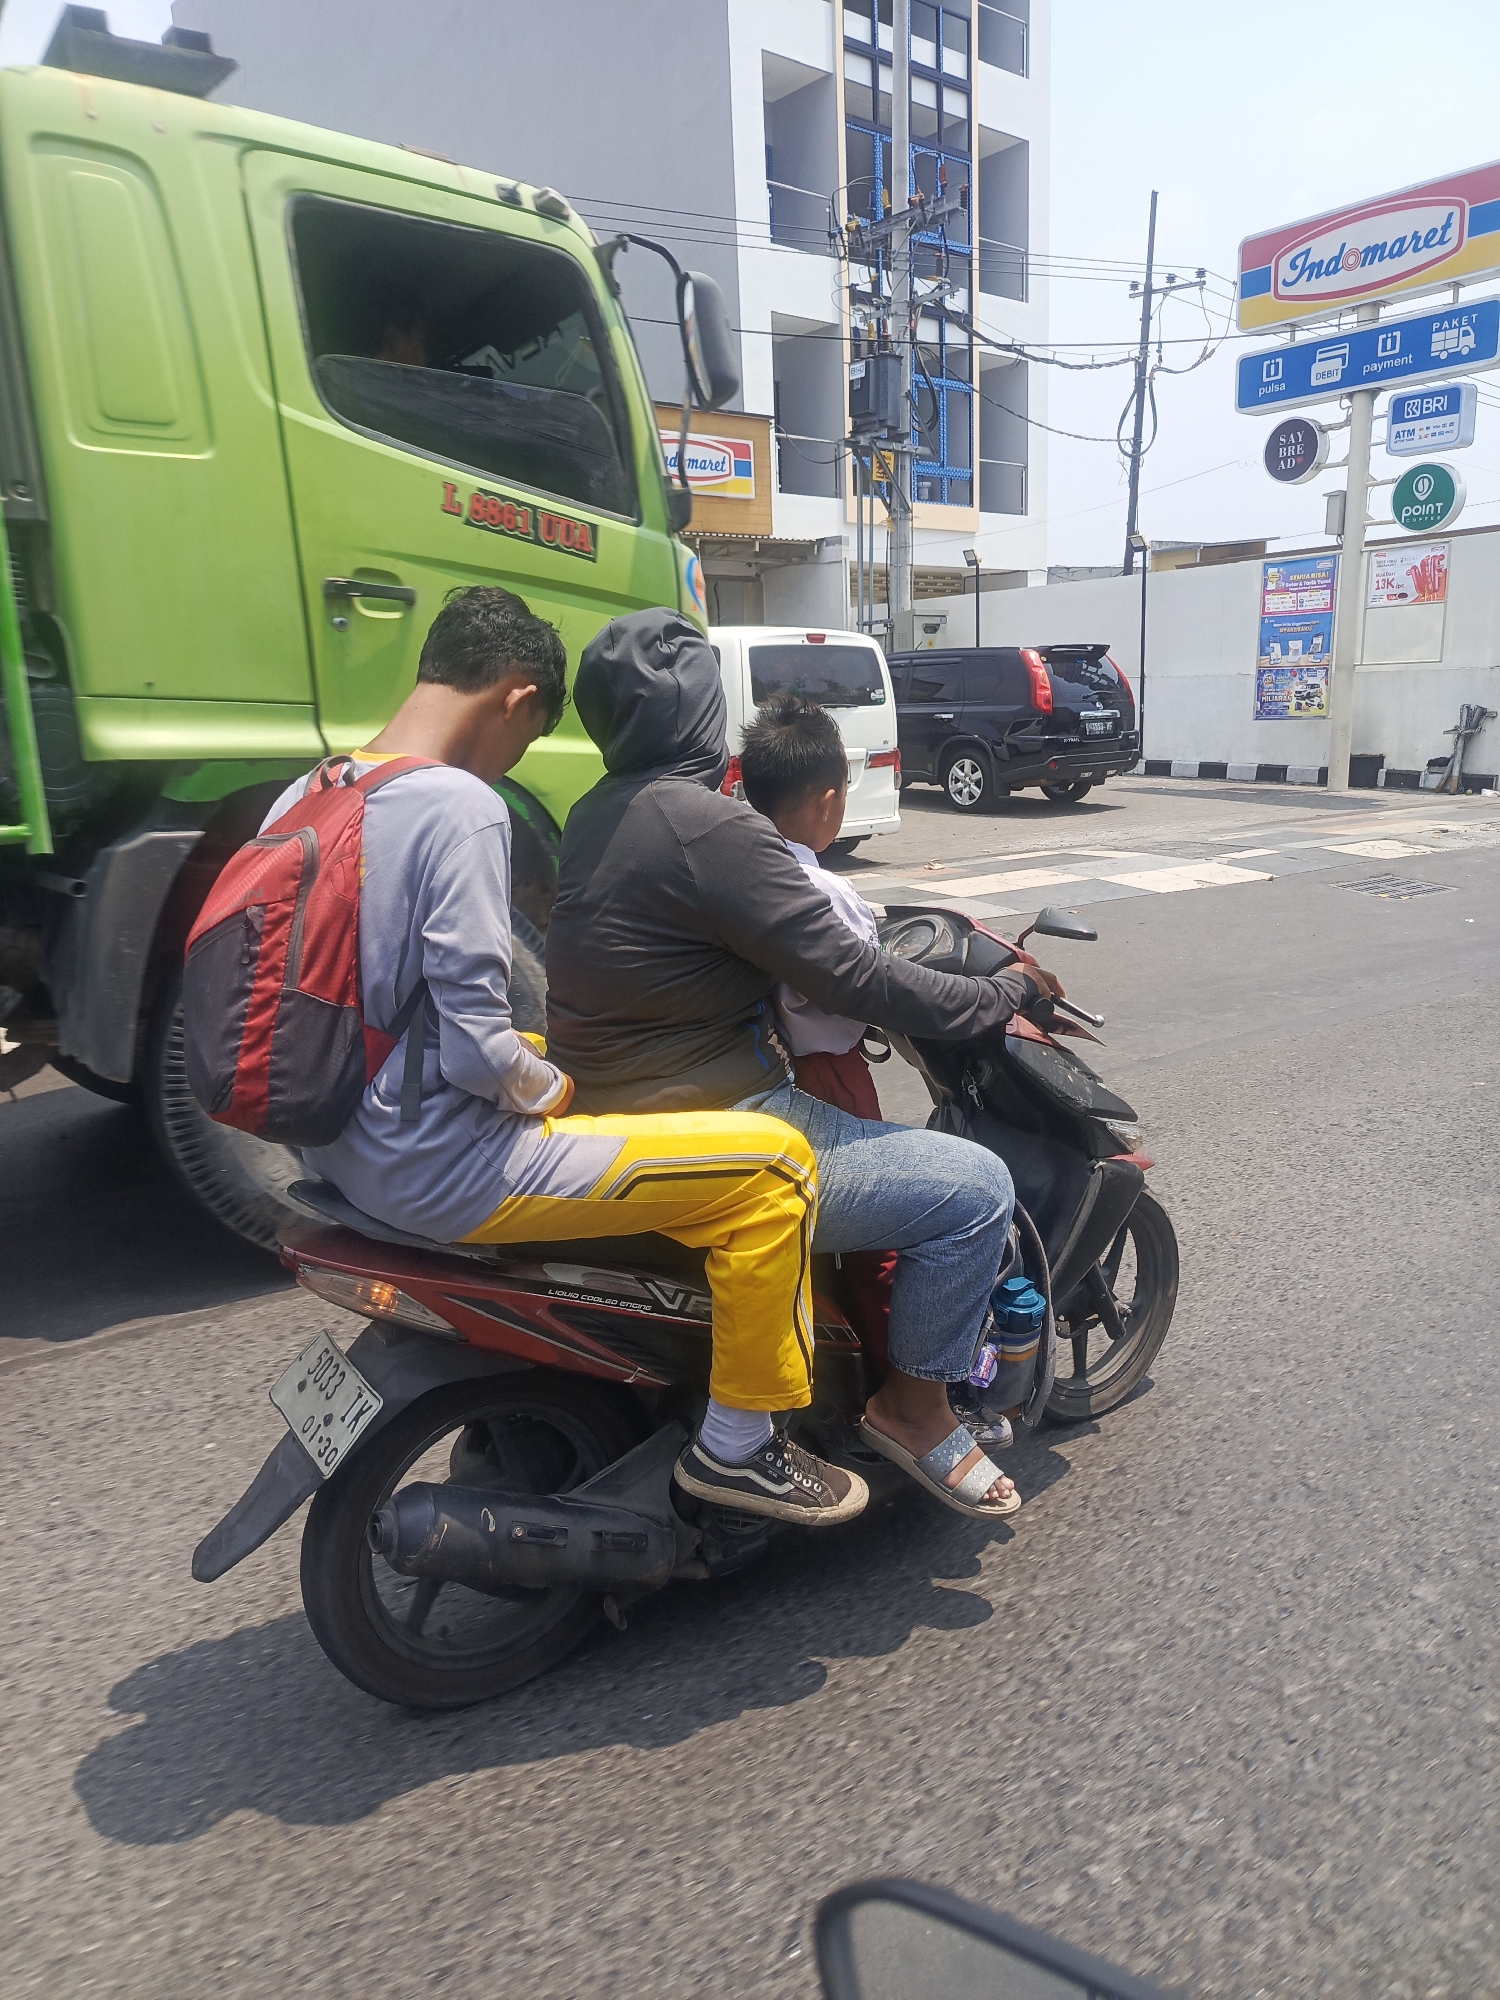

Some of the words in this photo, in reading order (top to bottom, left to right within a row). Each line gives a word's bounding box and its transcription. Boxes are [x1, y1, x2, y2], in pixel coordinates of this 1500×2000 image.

[1282, 211, 1454, 287] Indomaret
[1432, 313, 1478, 332] PAKET
[1363, 353, 1413, 376] payment
[1315, 367, 1340, 381] DEBIT
[1258, 382, 1286, 397] pulsa
[1422, 395, 1448, 414] BRI
[1279, 430, 1305, 446] SAY
[1394, 428, 1416, 440] ATM
[1279, 443, 1304, 458] BRE
[1277, 457, 1296, 471] AD
[442, 481, 463, 517] L
[470, 491, 532, 537] 8861
[538, 510, 594, 554] UUA
[1405, 515, 1441, 523] COFFEE
[1375, 577, 1395, 590] 13K
[548, 1289, 579, 1299] LIQUID
[580, 1294, 618, 1306] COOLED
[307, 1347, 347, 1401] 5033
